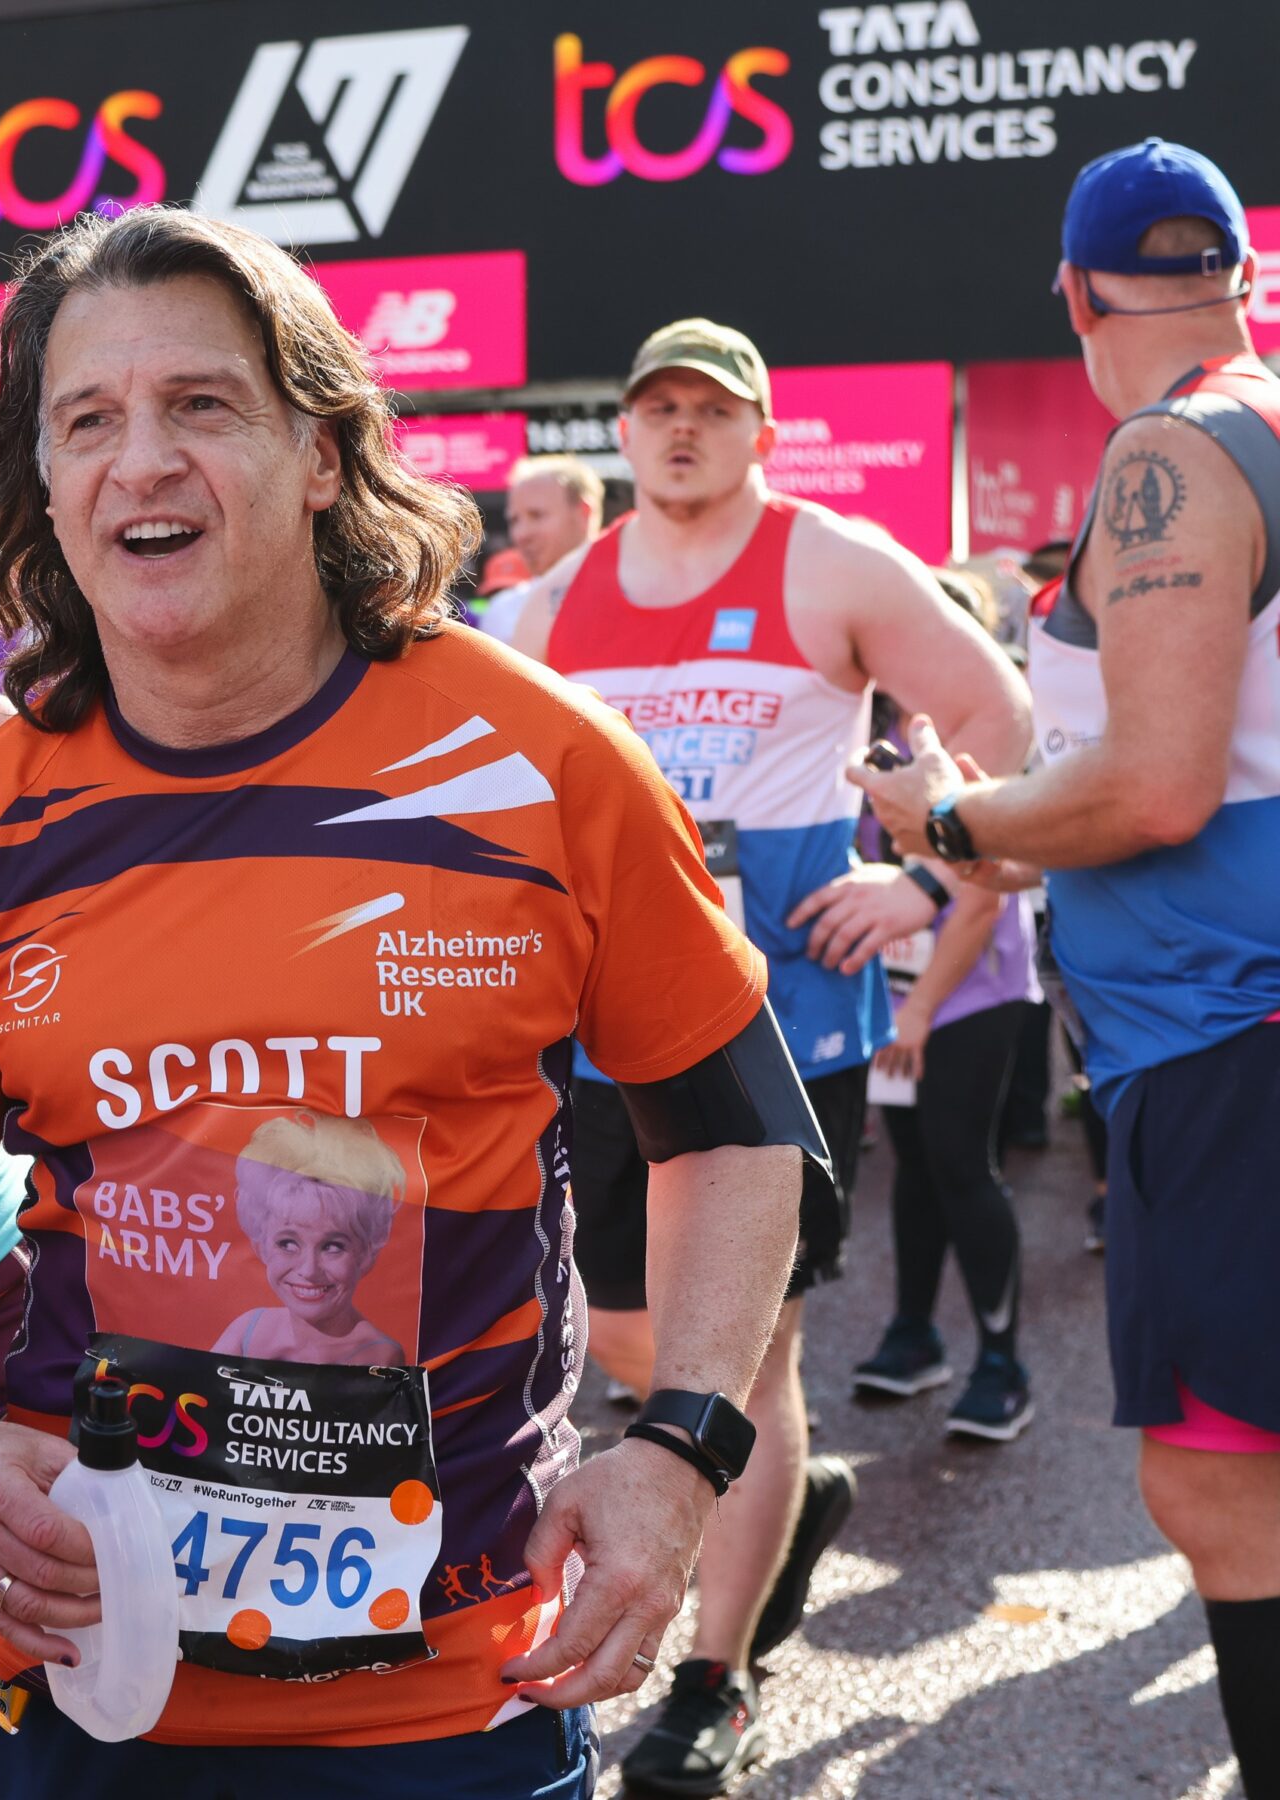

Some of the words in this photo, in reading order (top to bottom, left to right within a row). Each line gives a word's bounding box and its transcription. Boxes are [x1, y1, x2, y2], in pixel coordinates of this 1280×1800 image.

[819, 0, 981, 56] TATA
[818, 38, 1198, 113] CONSULTANCY
[554, 31, 794, 188] tcs
[819, 106, 1057, 171] SERVICES
[650, 730, 751, 764] NCER
[375, 929, 543, 957] Alzheimer's
[376, 960, 517, 987] Research
[380, 991, 427, 1017] UK
[88, 1036, 382, 1129] SCOTT
[92, 1181, 226, 1233] BABS'
[97, 1223, 232, 1281] ARMY
[228, 1382, 313, 1412] TATA
[226, 1412, 420, 1447] CONSULTANCY
[224, 1440, 349, 1475] SERVICES
[193, 1484, 298, 1509] #WeRunTogether
